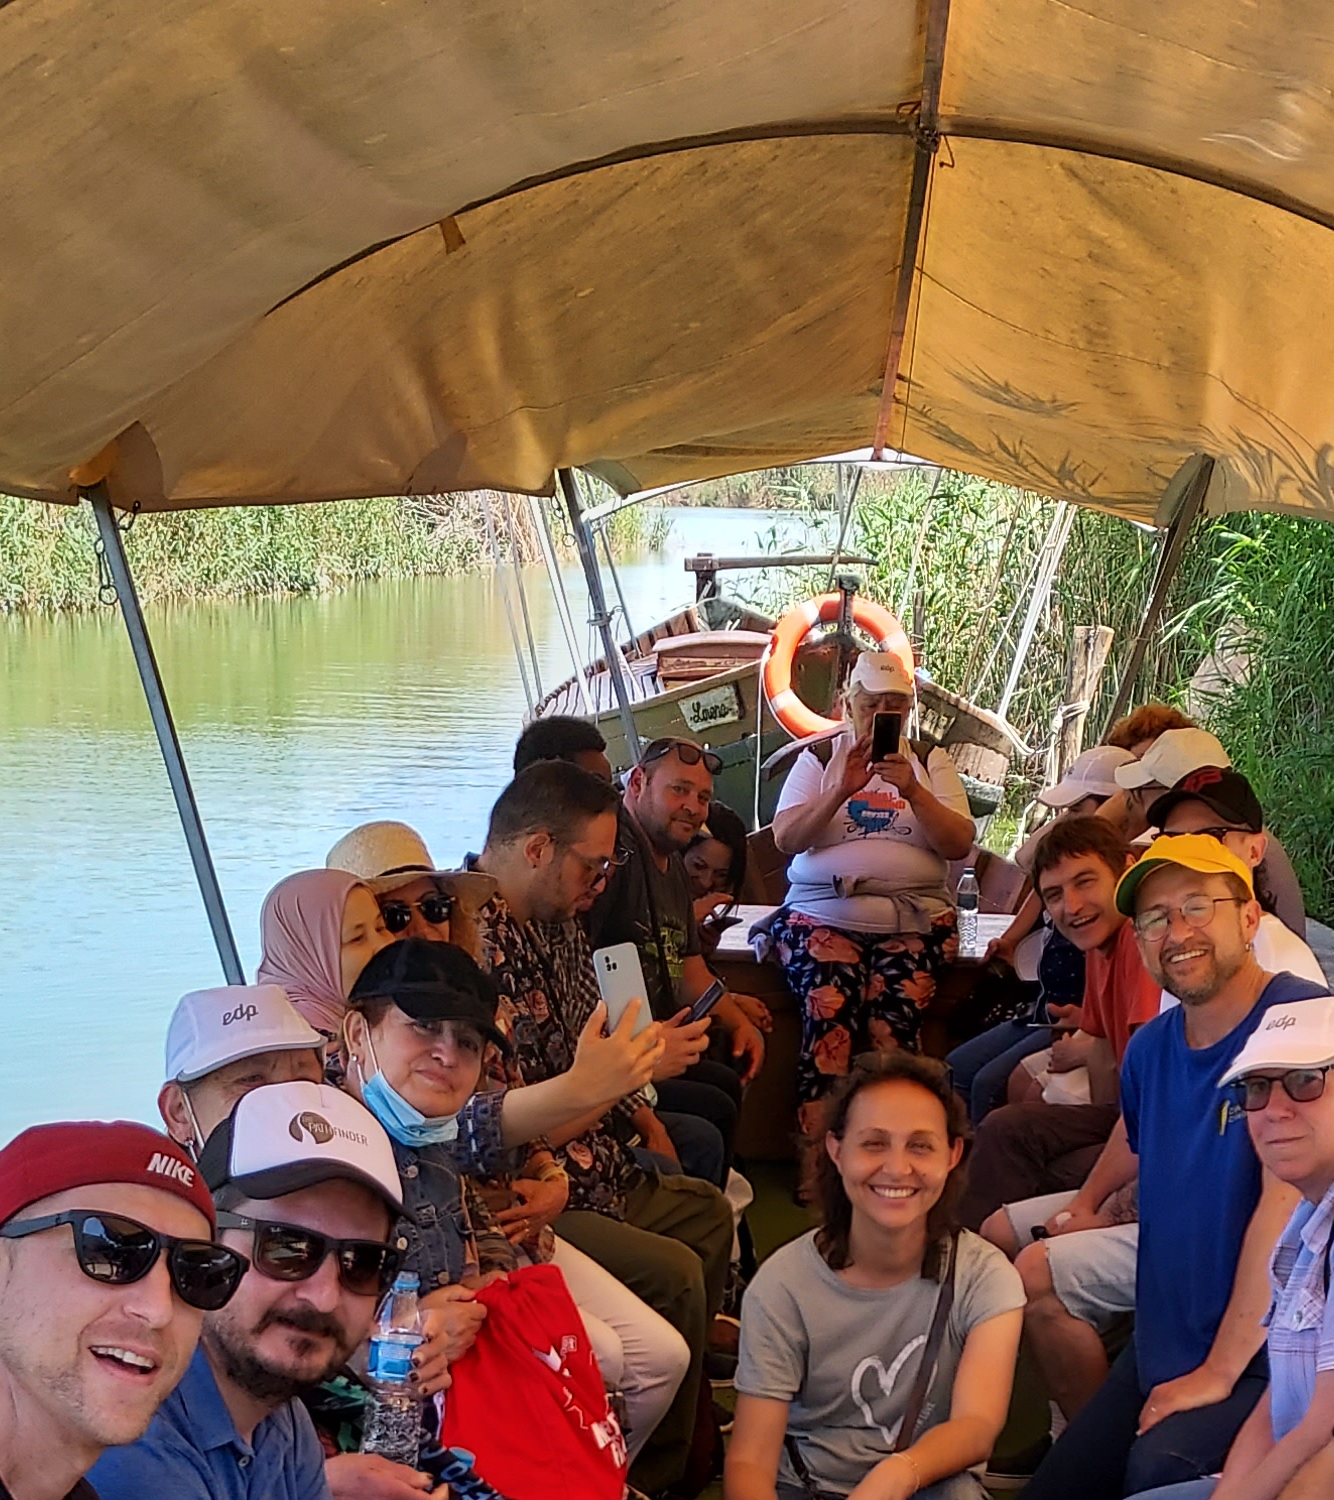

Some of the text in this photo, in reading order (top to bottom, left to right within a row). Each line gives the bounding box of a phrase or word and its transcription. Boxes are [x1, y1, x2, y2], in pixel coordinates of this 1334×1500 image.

[222, 1003, 259, 1026] edp
[1266, 1014, 1296, 1031] edp
[147, 1152, 195, 1188] NIKE
